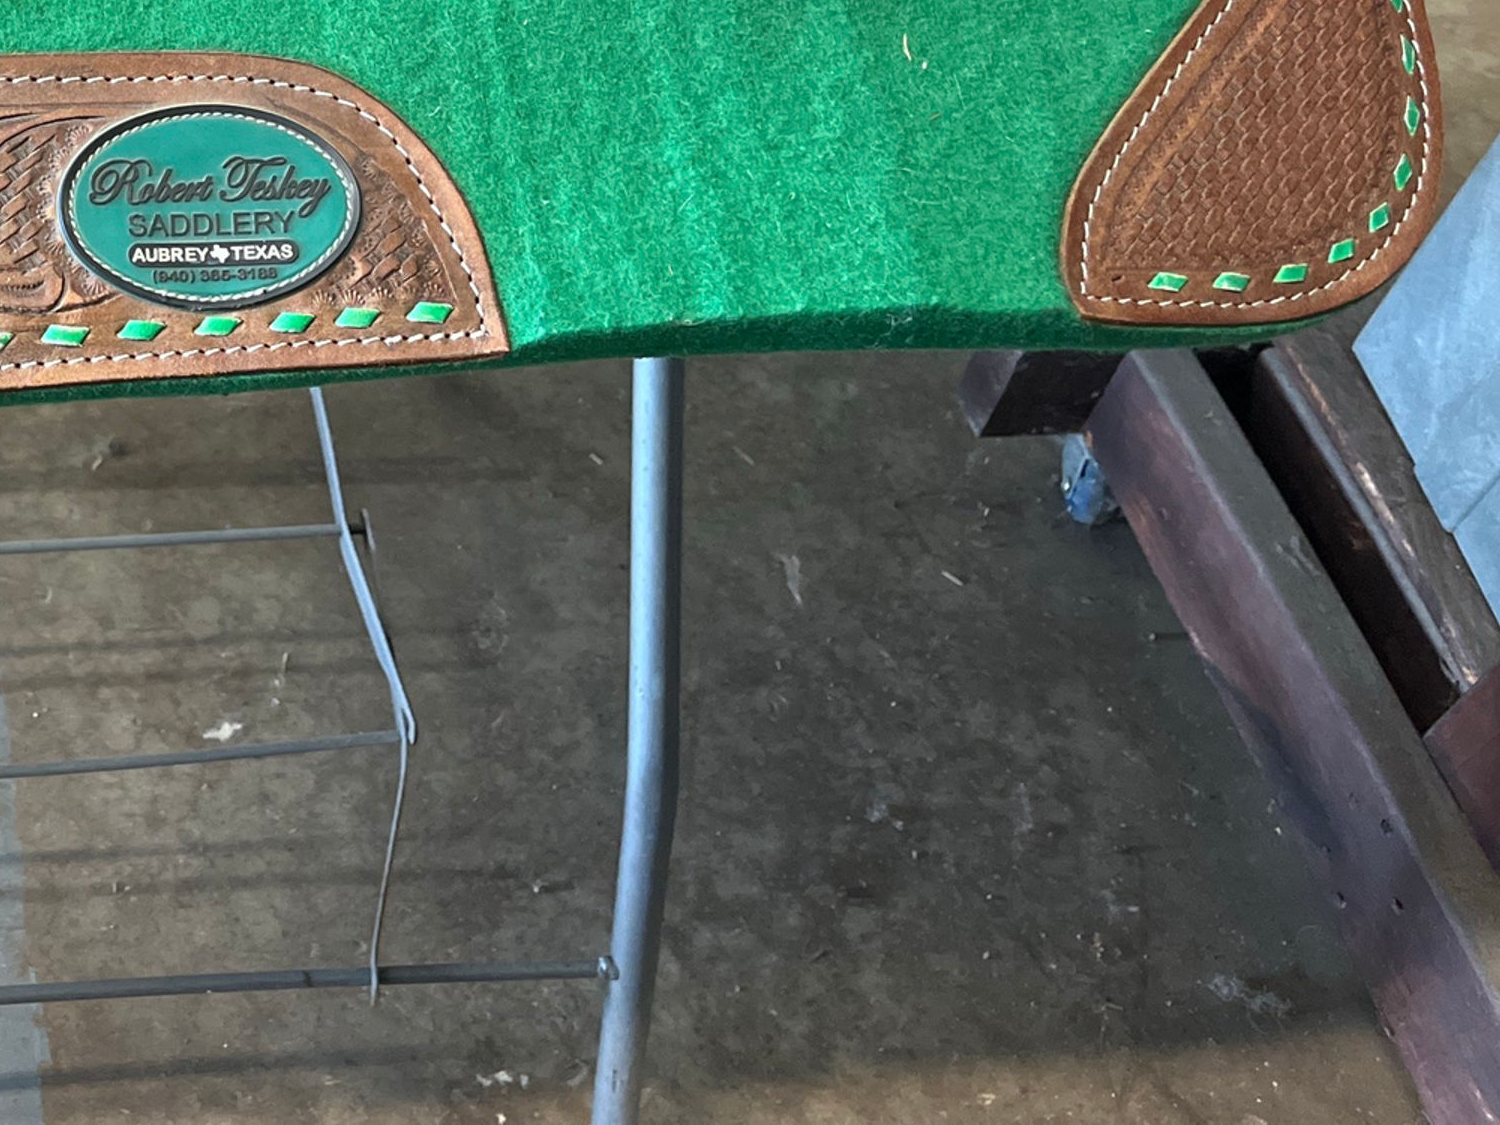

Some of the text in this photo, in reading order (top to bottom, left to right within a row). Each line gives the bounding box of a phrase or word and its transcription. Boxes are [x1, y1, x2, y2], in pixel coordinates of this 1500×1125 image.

[90, 156, 331, 217] Robert Teskey
[128, 210, 295, 237] SADDLERY
[131, 245, 293, 263] AUBREY TEXAS
[152, 269, 196, 284] (940)
